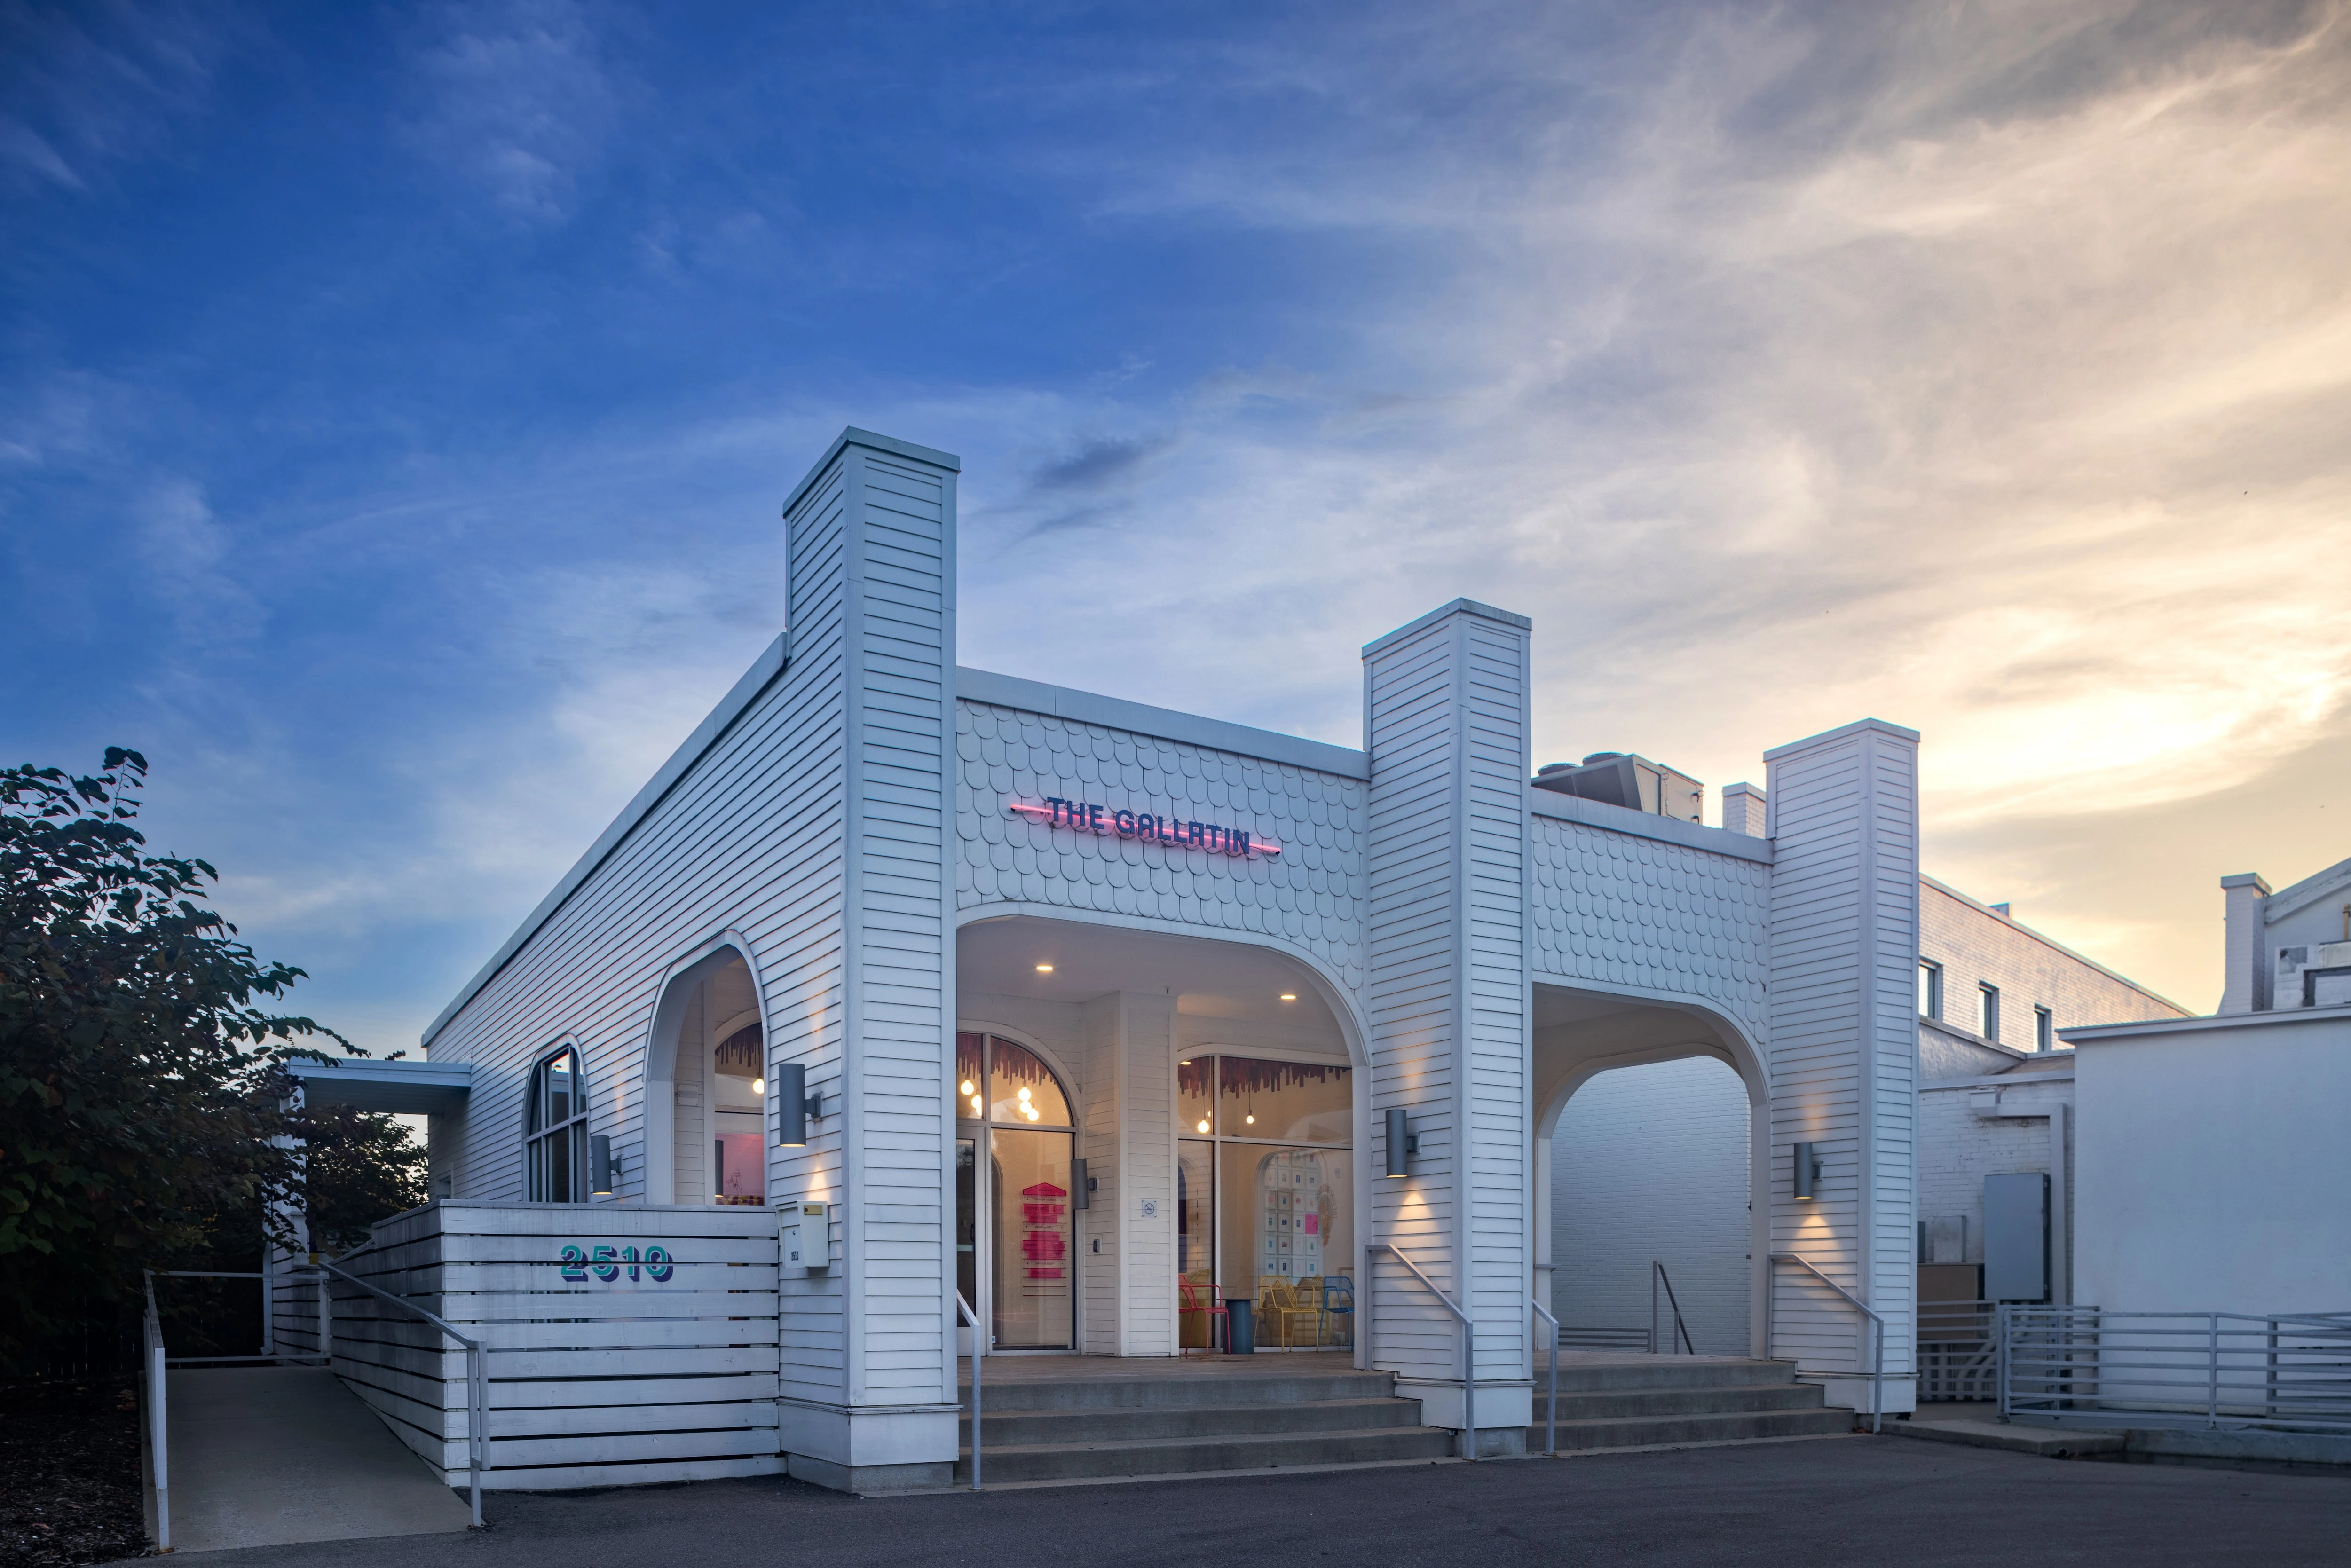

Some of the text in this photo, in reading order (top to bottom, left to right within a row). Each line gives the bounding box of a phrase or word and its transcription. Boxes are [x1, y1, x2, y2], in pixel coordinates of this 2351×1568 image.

[1047, 796, 1249, 854] THE GALLATIN
[560, 1245, 674, 1282] 2510
